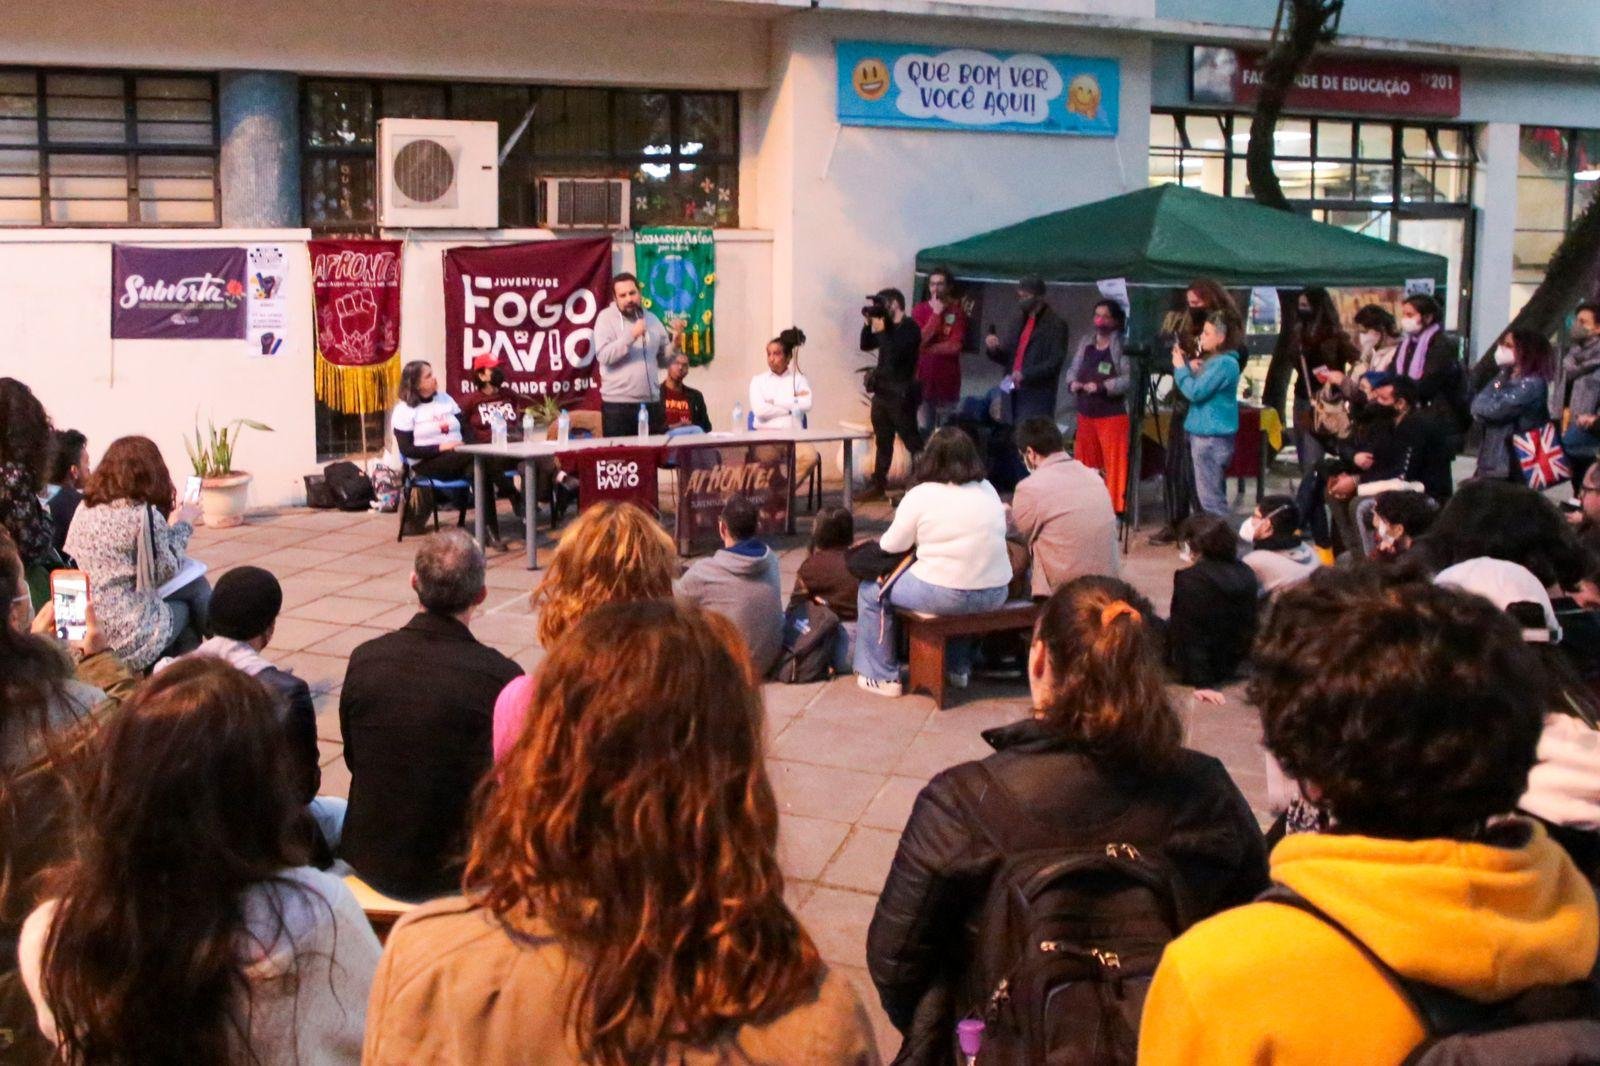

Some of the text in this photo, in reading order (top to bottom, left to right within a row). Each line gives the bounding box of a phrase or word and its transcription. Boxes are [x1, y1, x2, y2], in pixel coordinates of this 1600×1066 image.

[908, 61, 1049, 90] QUE BOM VER
[1322, 75, 1339, 90] DE
[1342, 78, 1411, 97] EDUCAÇÃO
[1431, 73, 1453, 90] 201
[920, 86, 975, 110] VOCÊ
[120, 272, 226, 309] Subverta
[494, 277, 559, 288] JUVENTUDE
[461, 274, 597, 328] FOGO
[552, 380, 571, 394] DO
[574, 376, 598, 392] SUL
[596, 460, 638, 476] FOGO
[597, 473, 639, 490] PAVIO
